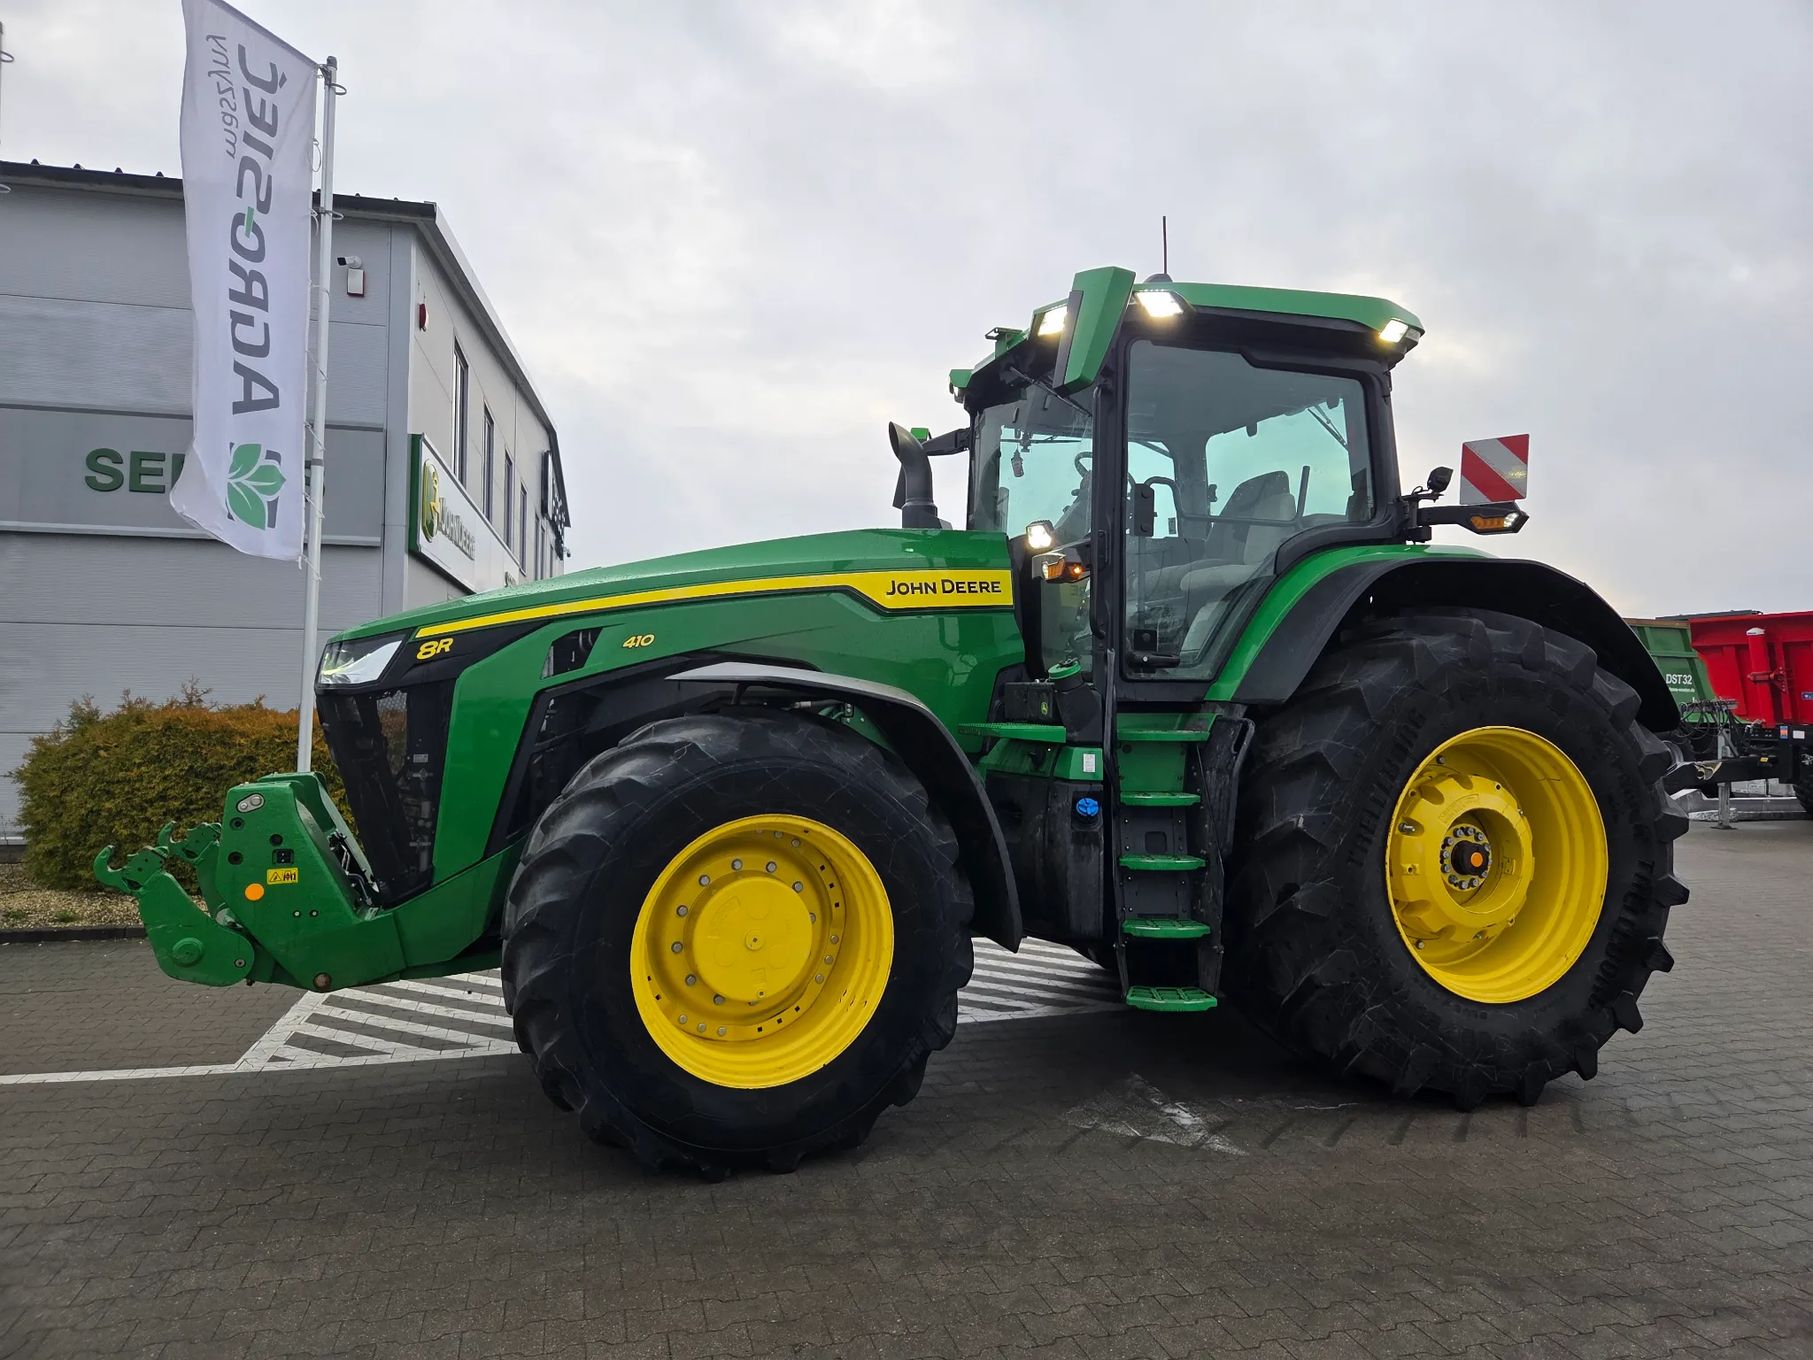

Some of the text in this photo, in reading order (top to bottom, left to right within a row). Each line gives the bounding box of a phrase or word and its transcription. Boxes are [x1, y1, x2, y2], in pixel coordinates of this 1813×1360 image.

[886, 579, 1002, 596] JOHN DEERE
[416, 637, 454, 660] 8R
[622, 634, 655, 649] 410
[1665, 673, 1693, 685] DST32
